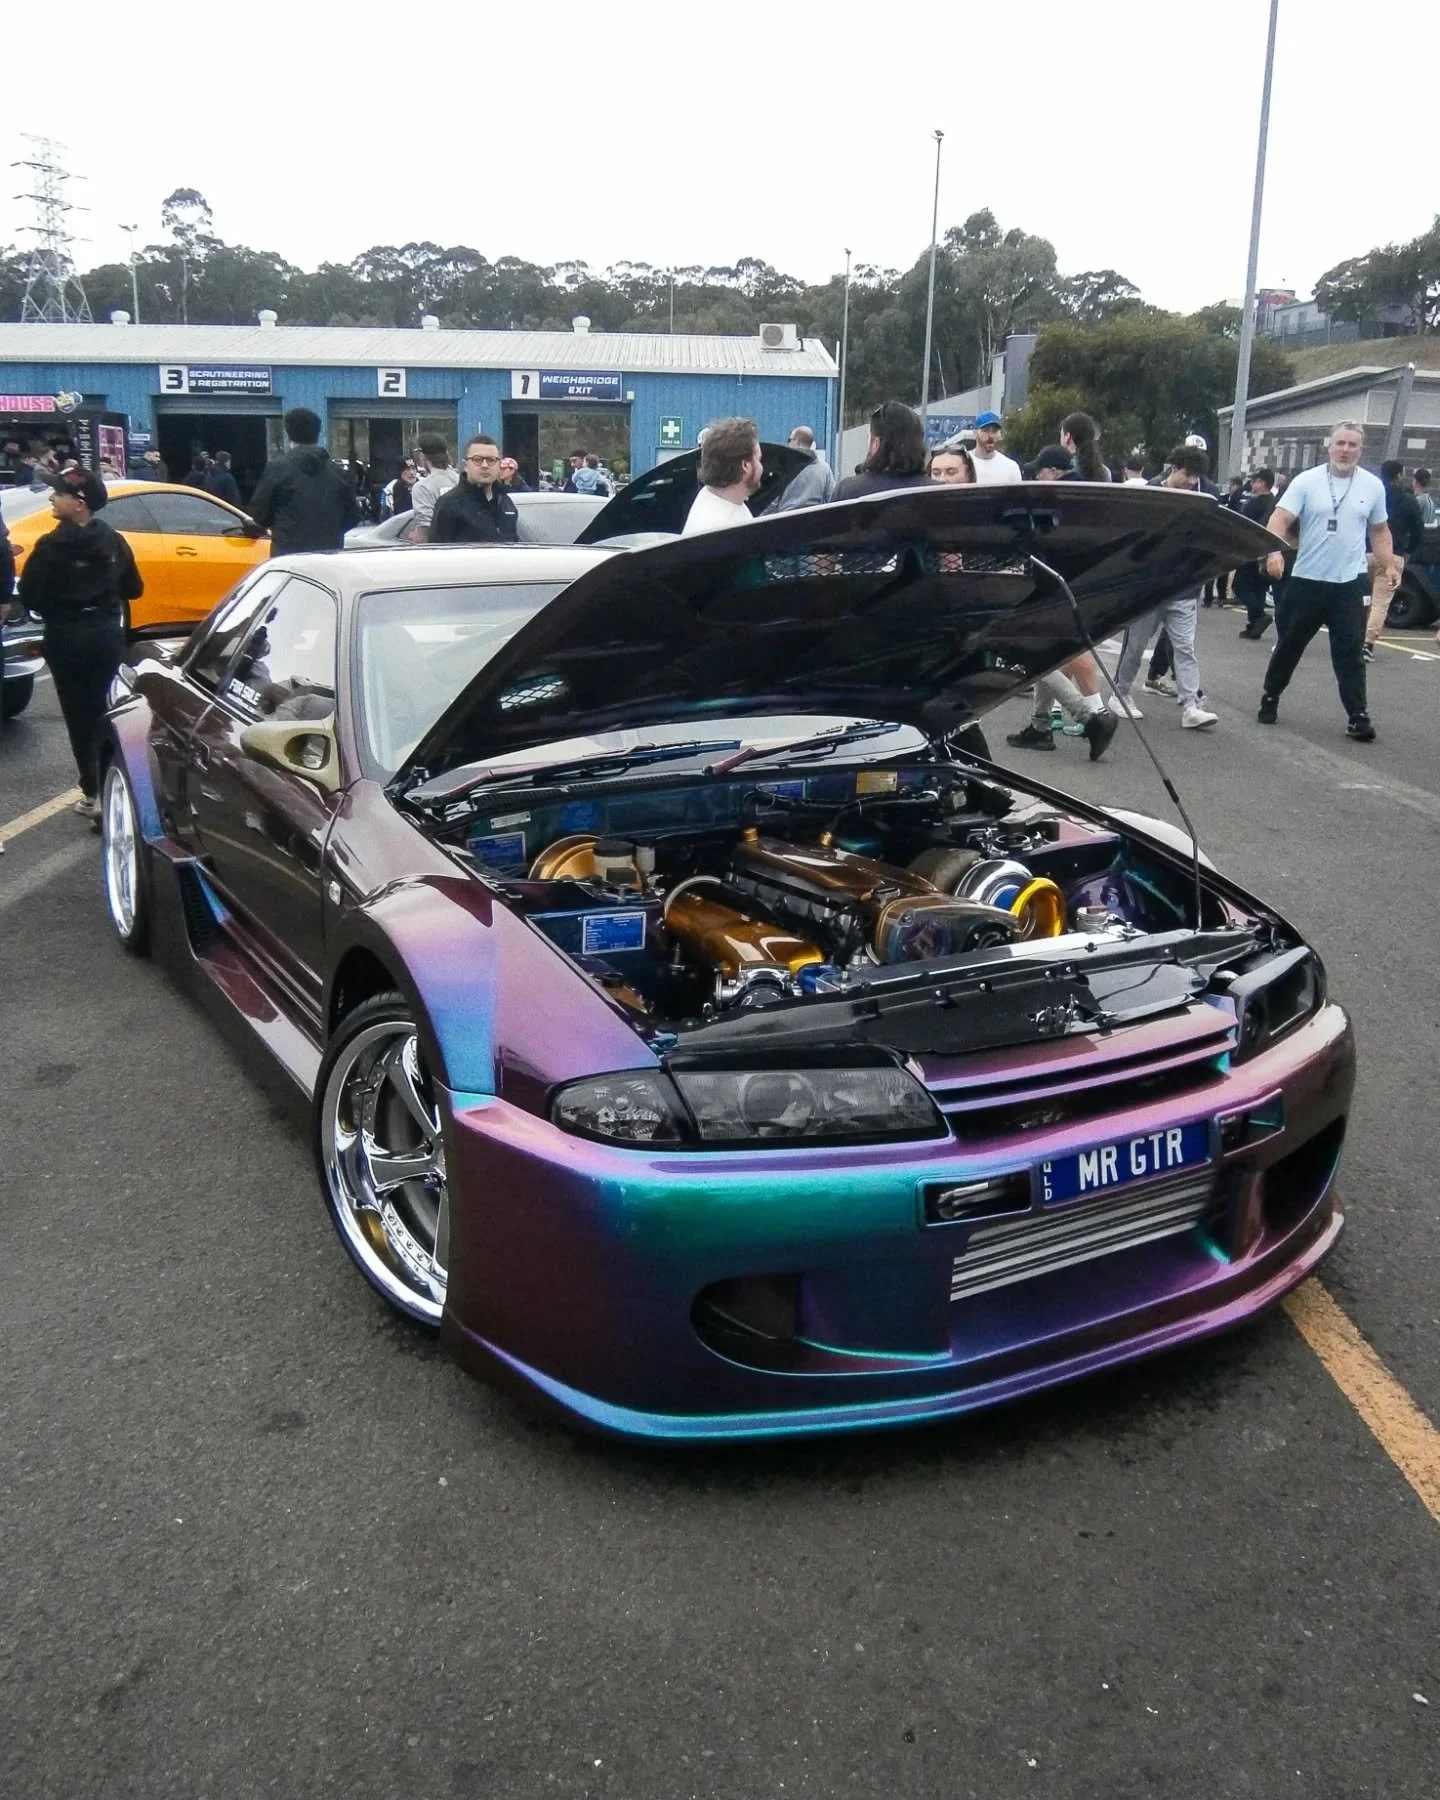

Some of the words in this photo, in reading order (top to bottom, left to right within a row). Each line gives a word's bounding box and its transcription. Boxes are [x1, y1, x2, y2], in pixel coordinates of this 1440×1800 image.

[166, 370, 183, 389] 3
[189, 371, 269, 379] SCRUTINEERING
[542, 375, 619, 385] WEIGHBRIDGE
[198, 380, 270, 388] REGISTRATION
[384, 373, 400, 392] 2
[521, 375, 530, 394] 1
[568, 386, 592, 394] EXIT
[1078, 1144, 1118, 1191] MR
[1130, 1127, 1184, 1176] GTR
